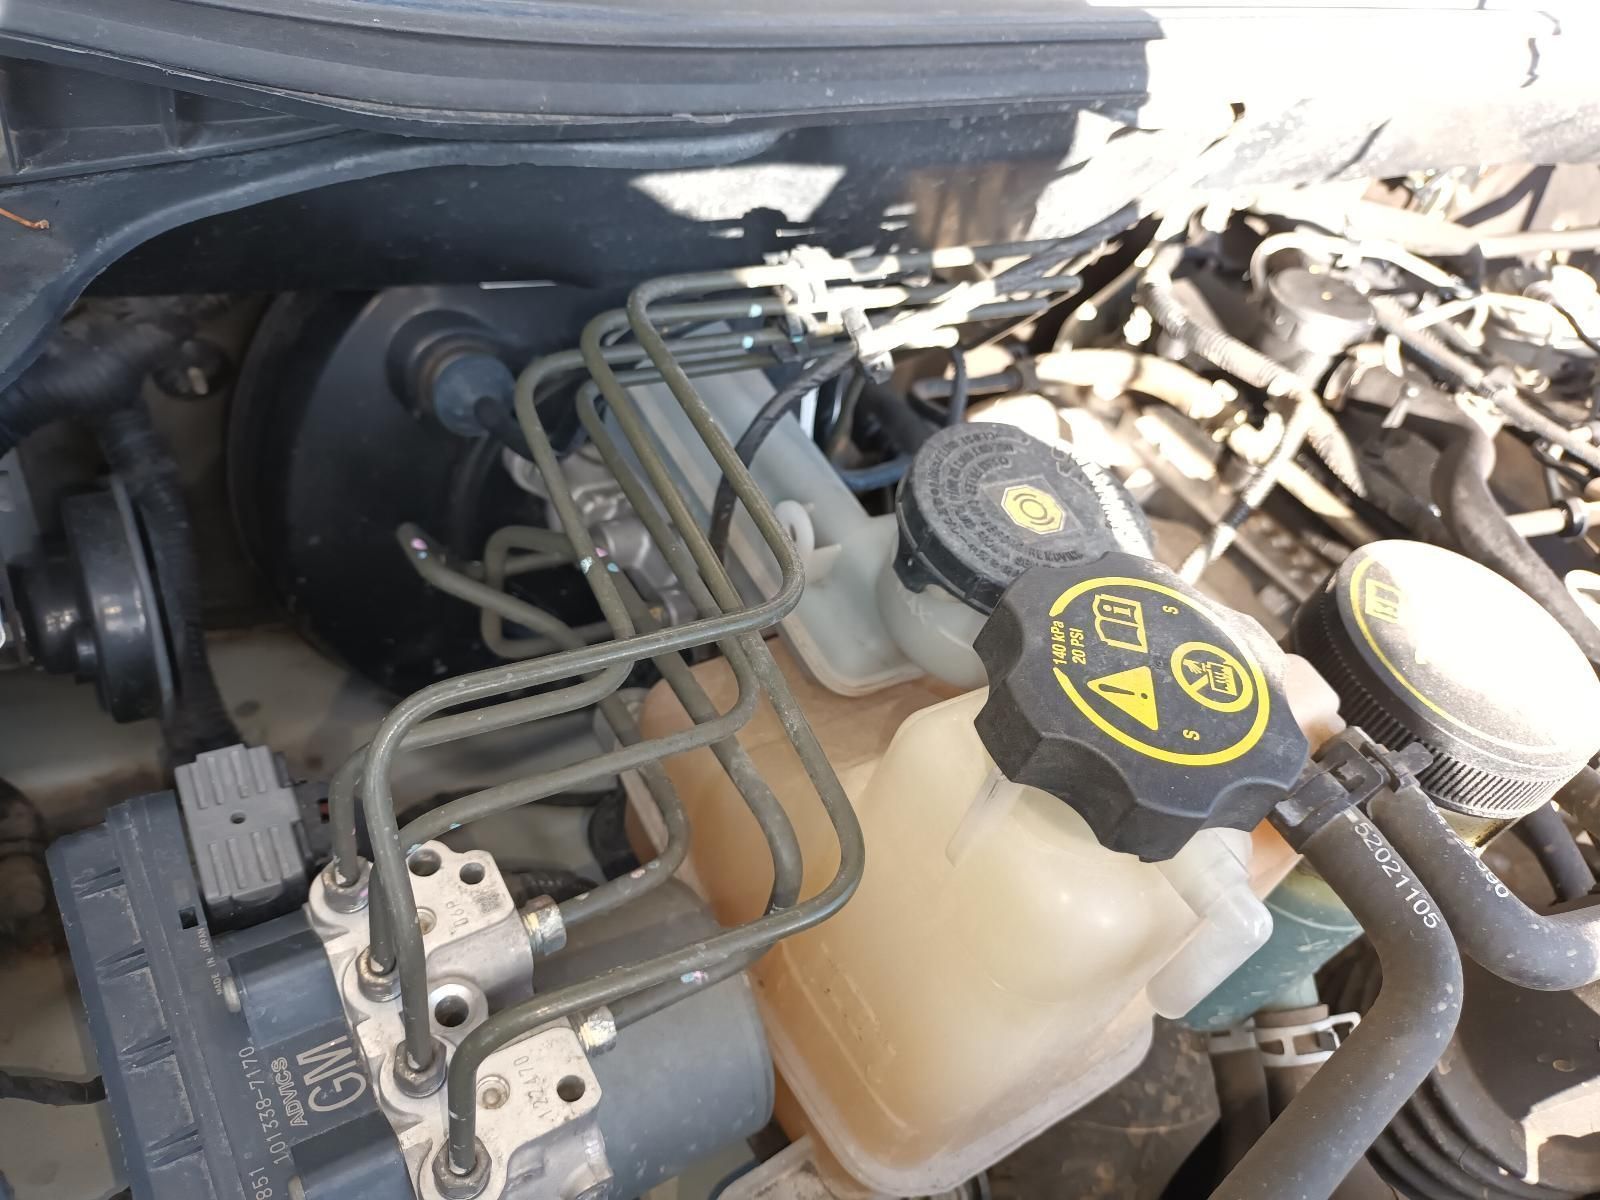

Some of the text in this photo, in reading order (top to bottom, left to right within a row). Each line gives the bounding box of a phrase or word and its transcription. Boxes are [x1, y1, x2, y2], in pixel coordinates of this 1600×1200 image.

[1051, 620, 1068, 665] 140 kPa
[1069, 627, 1087, 665] 20 PSI
[1354, 821, 1442, 930] 52021105
[197, 927, 224, 996] MADE IN JAPAN
[238, 1046, 288, 1166] 101338-7170
[270, 1056, 309, 1127] ADVICS
[295, 1034, 368, 1113] GM
